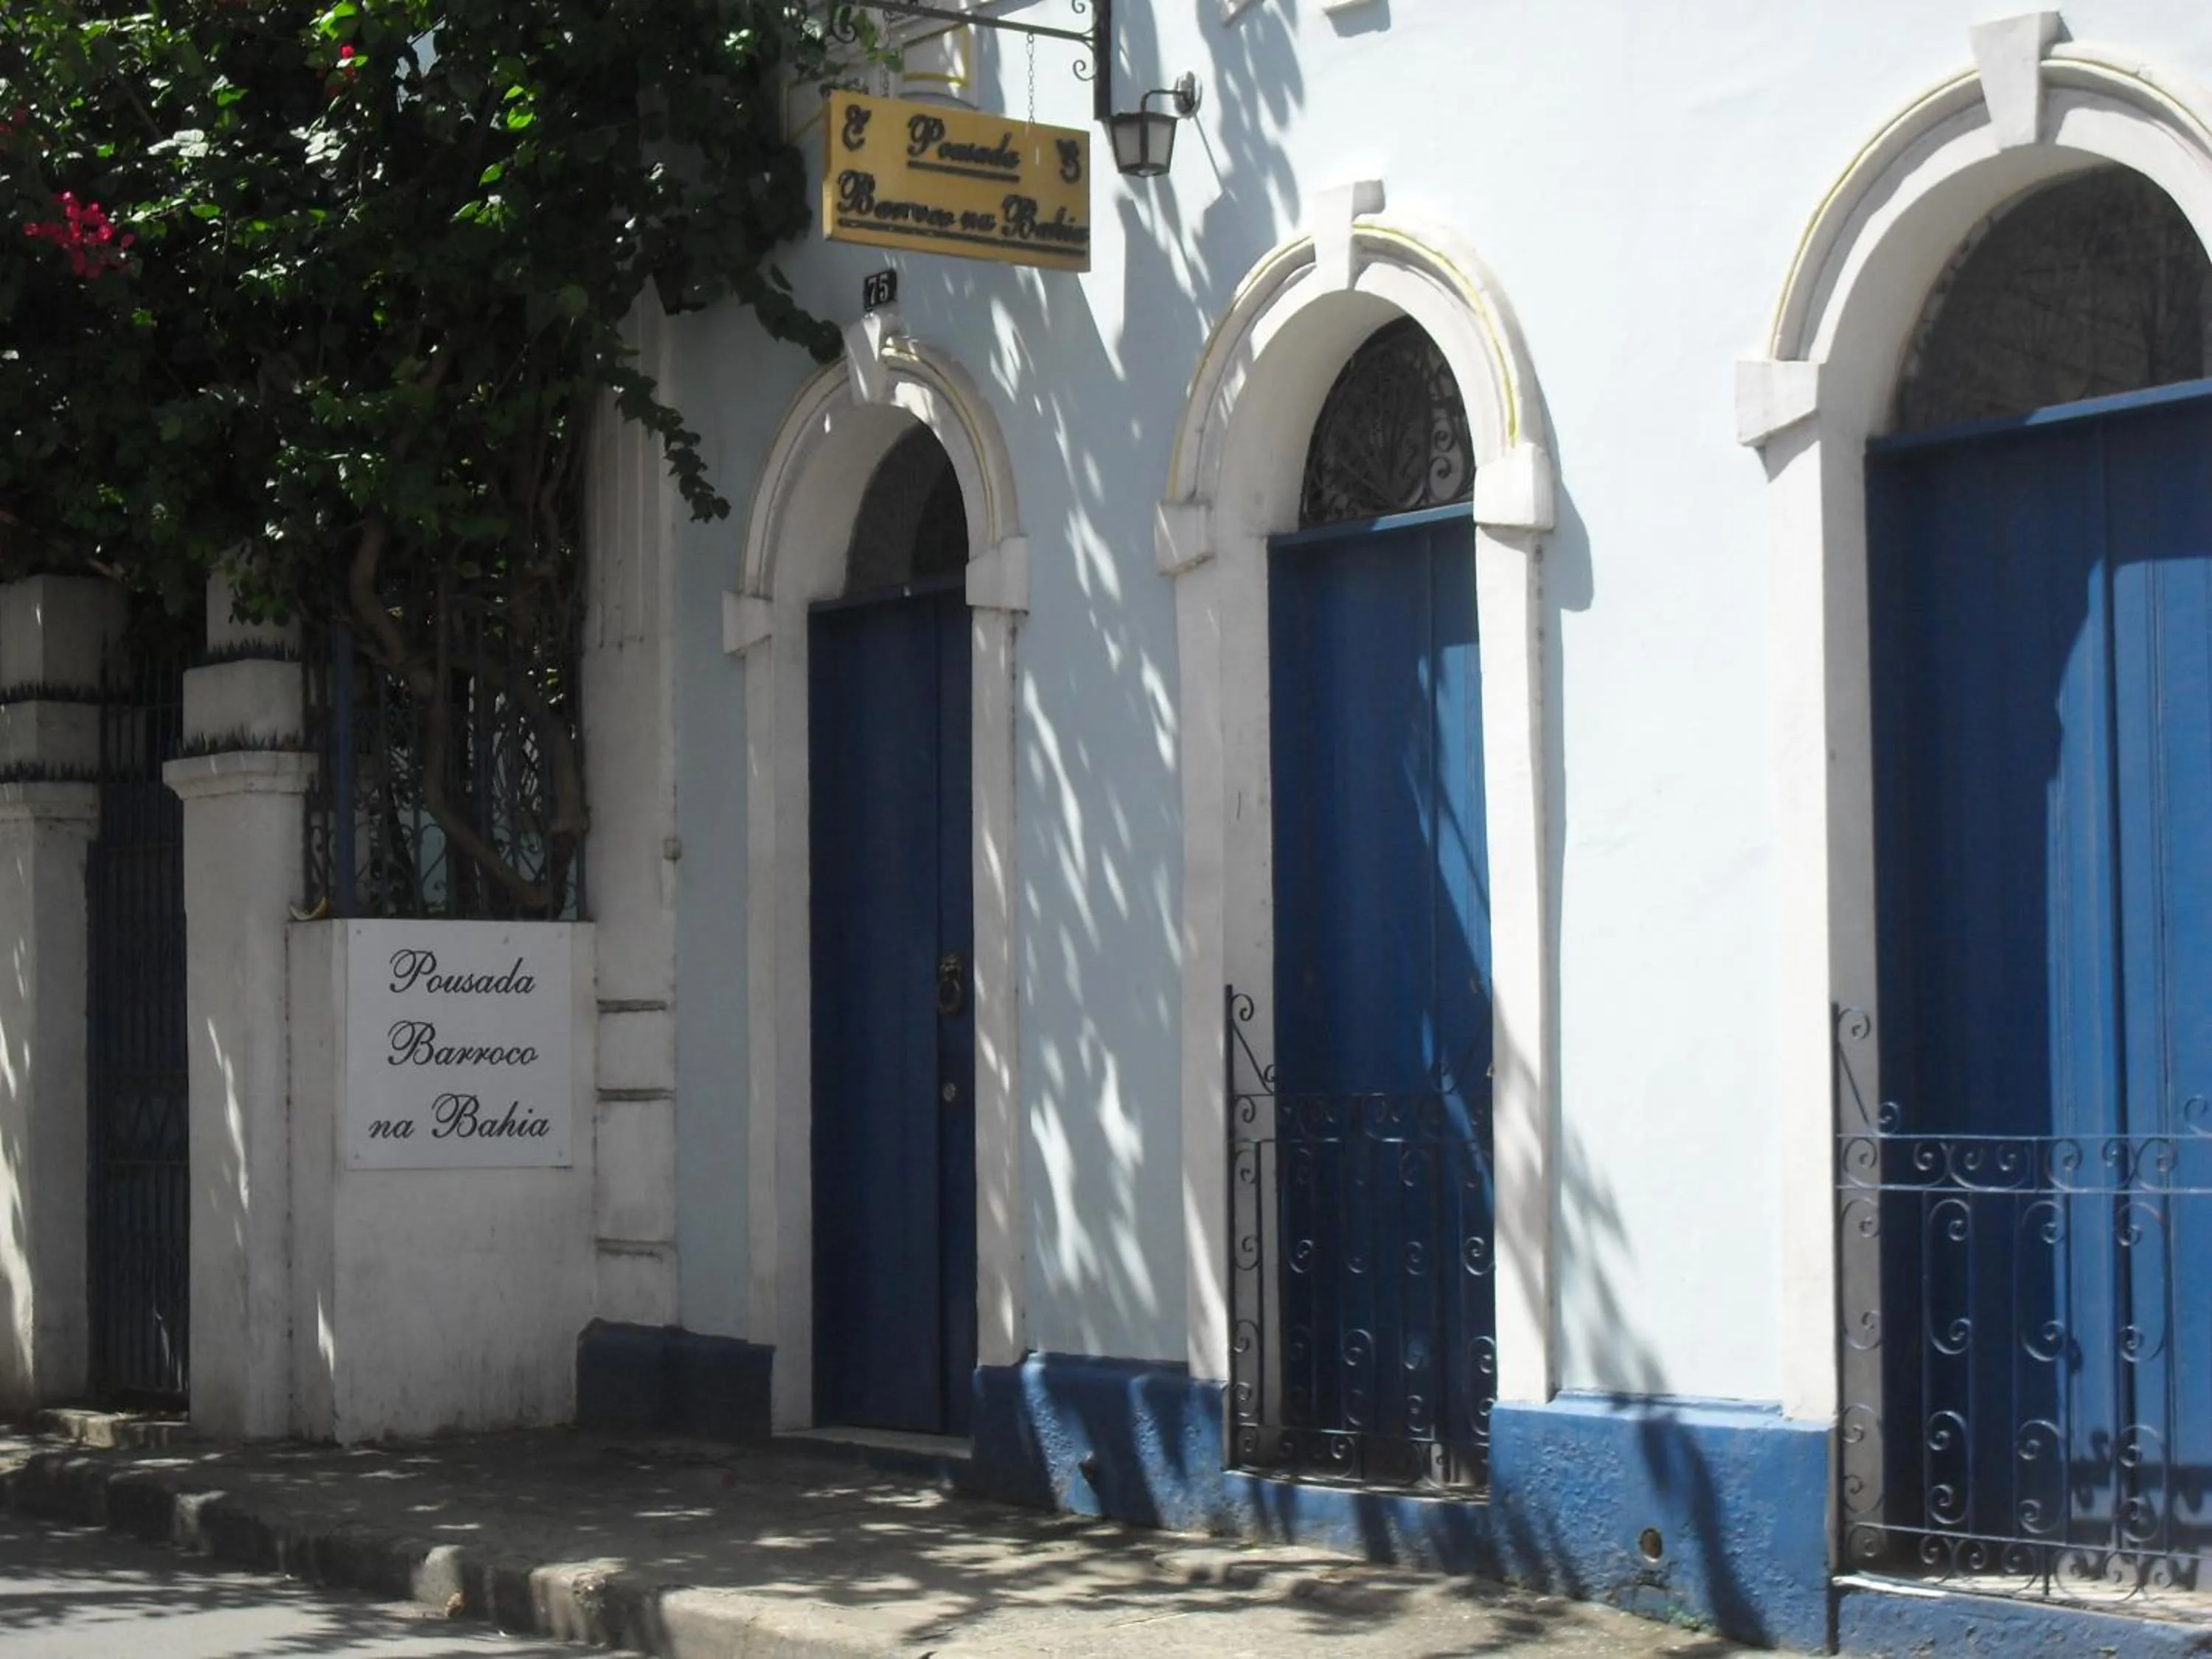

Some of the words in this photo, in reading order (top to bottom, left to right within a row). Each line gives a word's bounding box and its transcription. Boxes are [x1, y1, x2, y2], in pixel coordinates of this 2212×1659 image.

[867, 274, 889, 305] 75
[389, 949, 536, 993] Pousada
[387, 1020, 538, 1065] Barroco
[369, 1119, 414, 1138] na
[431, 1093, 550, 1138] Bahia
